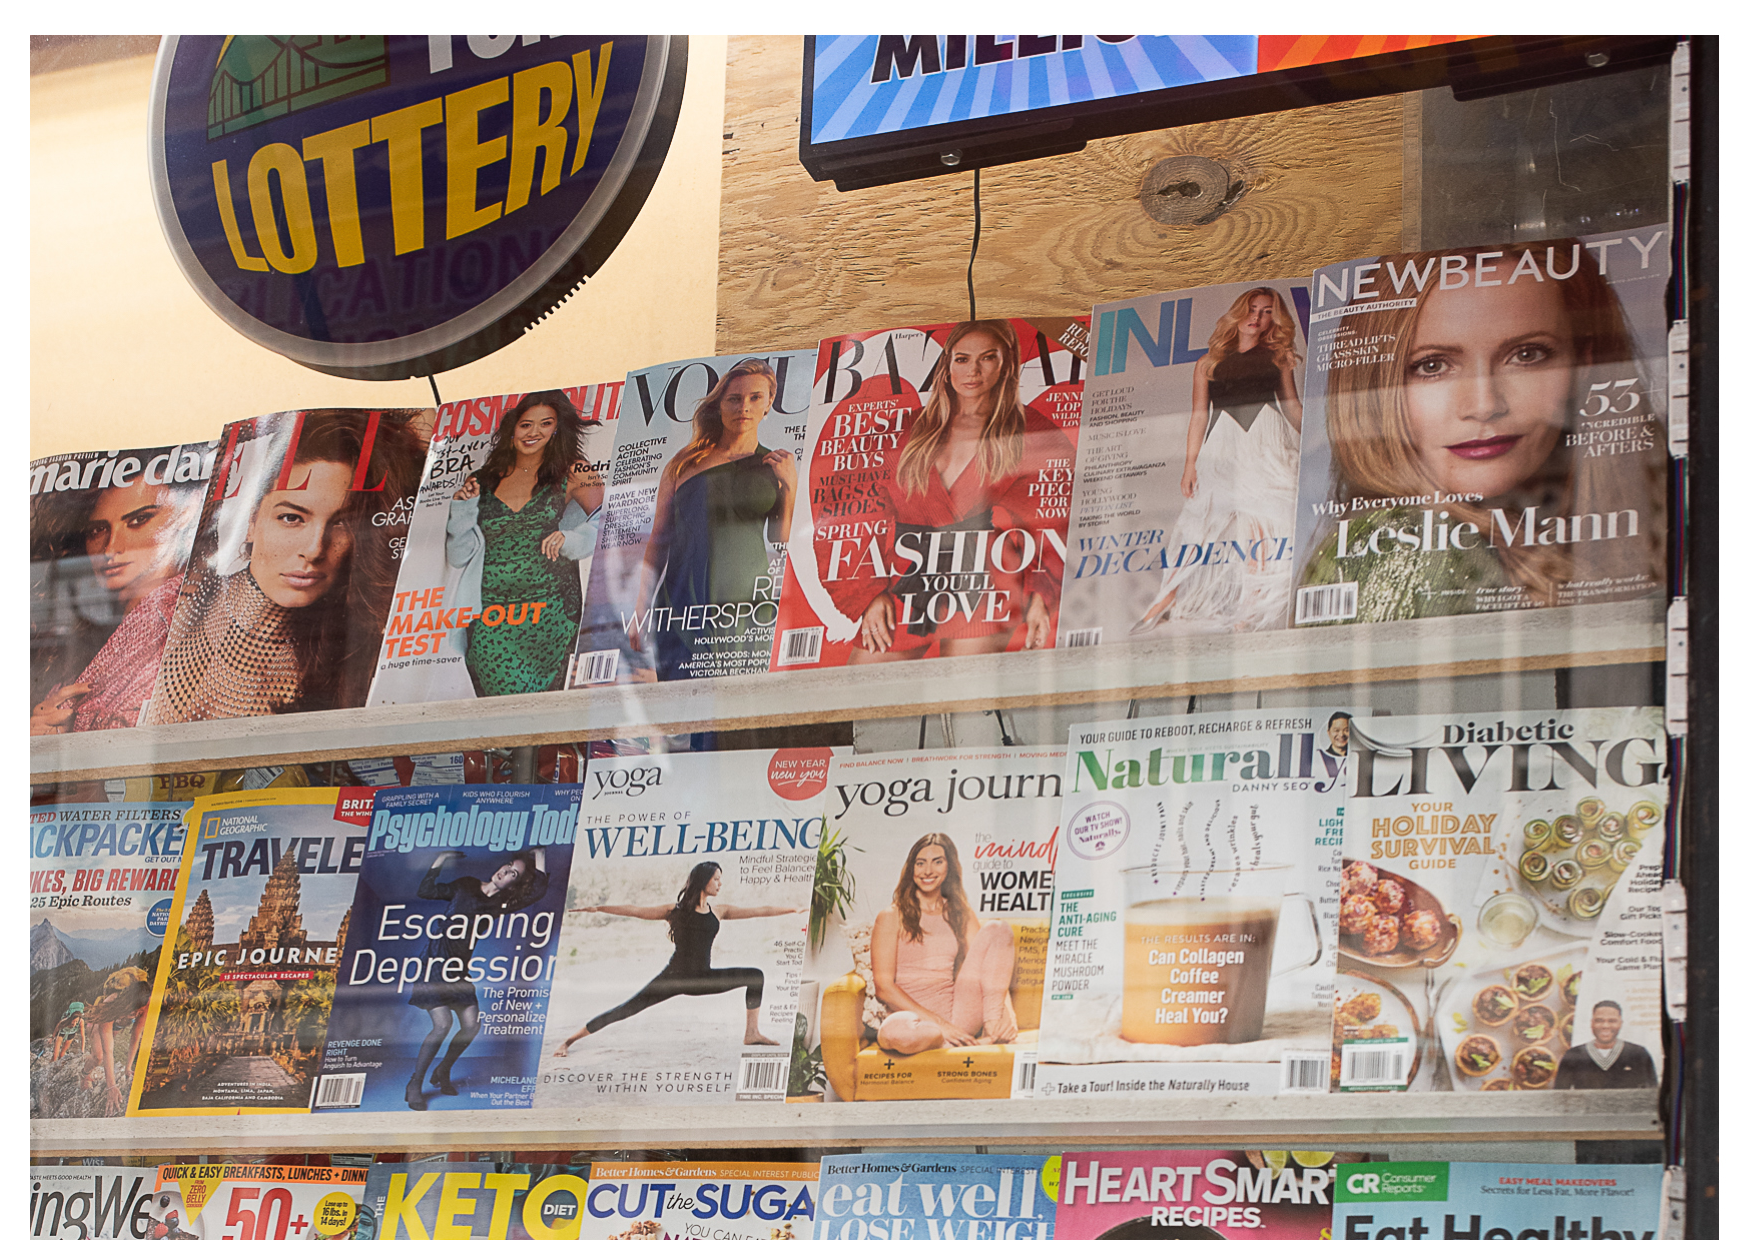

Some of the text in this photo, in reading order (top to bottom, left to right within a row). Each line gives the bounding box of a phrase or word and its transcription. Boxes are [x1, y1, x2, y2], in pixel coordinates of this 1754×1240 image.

[211, 41, 614, 274] LOTTERY
[1316, 231, 1665, 308] NEWBEAUTY
[1317, 301, 1413, 321] THE BEAUTY AUTHORITY
[831, 409, 911, 439] BEST
[819, 433, 903, 457] BEAUTY
[833, 452, 885, 472] BUYS
[1336, 506, 1640, 559] Leslie Mann
[922, 574, 995, 593] YOU'LL
[395, 587, 443, 614] THE
[899, 591, 1011, 626] LOVE
[388, 602, 546, 635] MAKE-OUT
[385, 633, 445, 659] TEST
[388, 660, 409, 672] huge
[411, 655, 462, 668] time-saver
[1443, 720, 1575, 745] Diabetic
[1351, 740, 1666, 798] LIVING
[593, 764, 663, 801] yoga
[219, 823, 267, 834] GEOGRAPHIC
[222, 815, 259, 827] NATIONAL
[587, 811, 692, 824] THE POWER OF
[1372, 814, 1498, 837] HOLIDAY
[1371, 836, 1497, 859] SURVIVAL
[378, 904, 555, 945] Escaping
[1149, 948, 1245, 972] Can Collagen
[233, 972, 277, 980] SPECTACULAR
[280, 971, 309, 979] ESCAPES
[1169, 968, 1219, 986] Coffee
[1161, 987, 1225, 1006] Creamer
[1155, 1007, 1228, 1025] Heal You?
